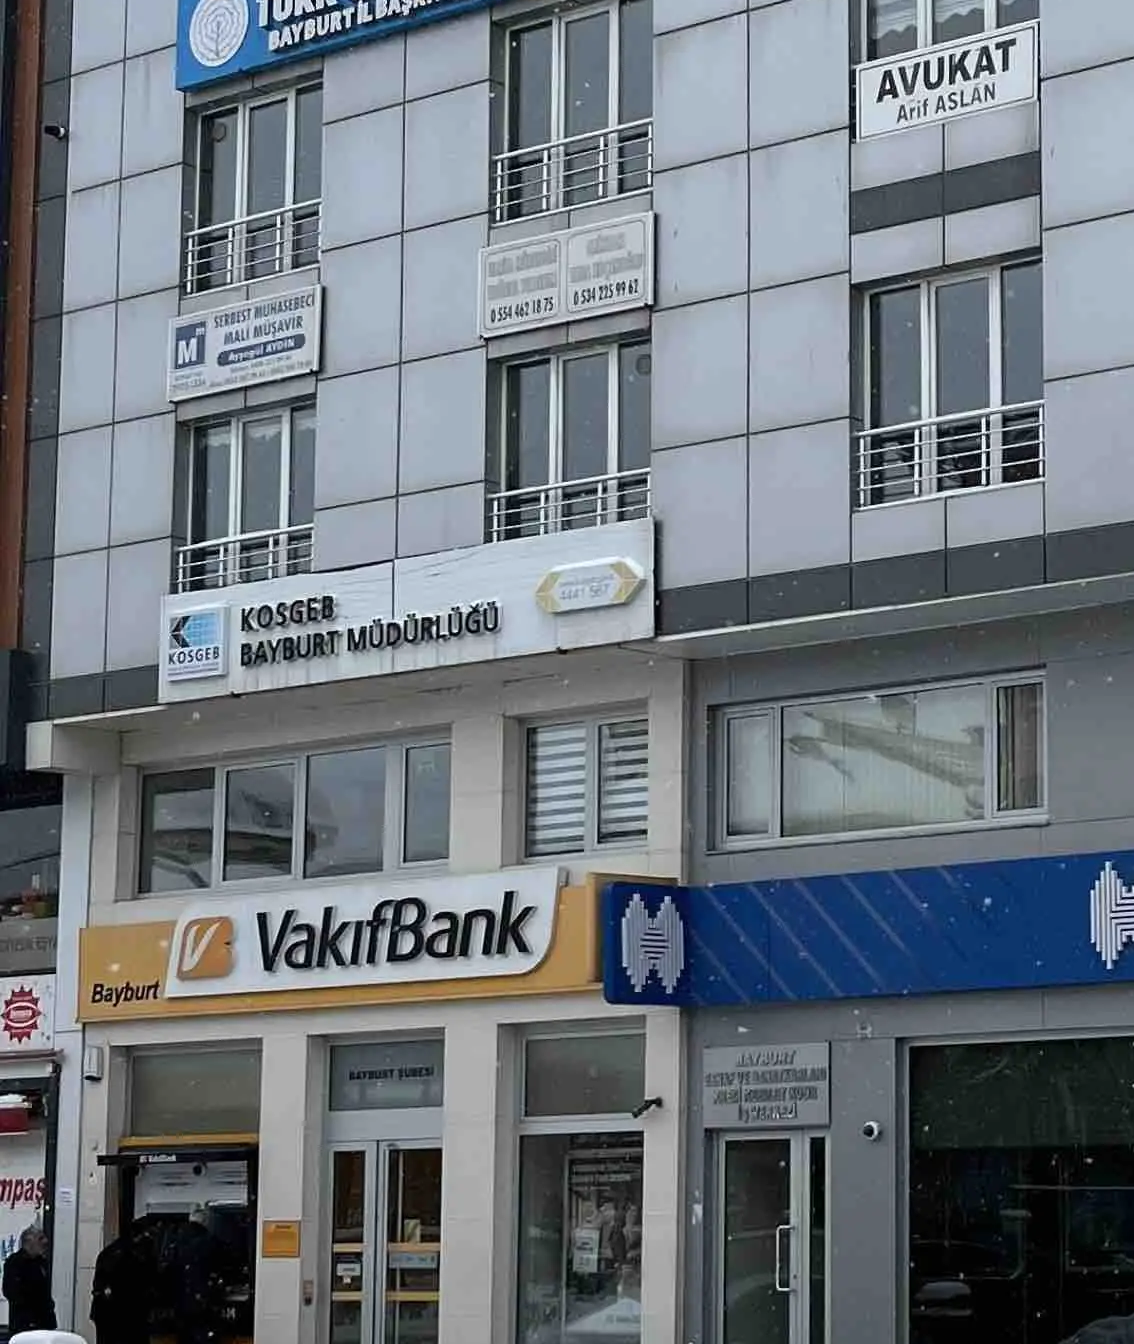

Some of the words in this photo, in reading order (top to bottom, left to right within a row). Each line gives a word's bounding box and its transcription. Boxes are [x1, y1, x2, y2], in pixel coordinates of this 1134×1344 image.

[268, 7, 355, 52] BAYBURT
[357, 0, 373, 25] İL
[876, 37, 1017, 103] AVUKAT
[896, 98, 929, 124] Arif
[935, 82, 996, 114] ASLAN
[214, 308, 252, 329] SERBEST
[240, 630, 341, 667] BAYBURT
[347, 601, 500, 652] MÜDÜRLÜĞÜ
[241, 595, 335, 632] KOSGEB
[169, 646, 220, 665] KOSGEB
[256, 890, 535, 973] VakıfBank
[91, 979, 161, 1007] Bayburt
